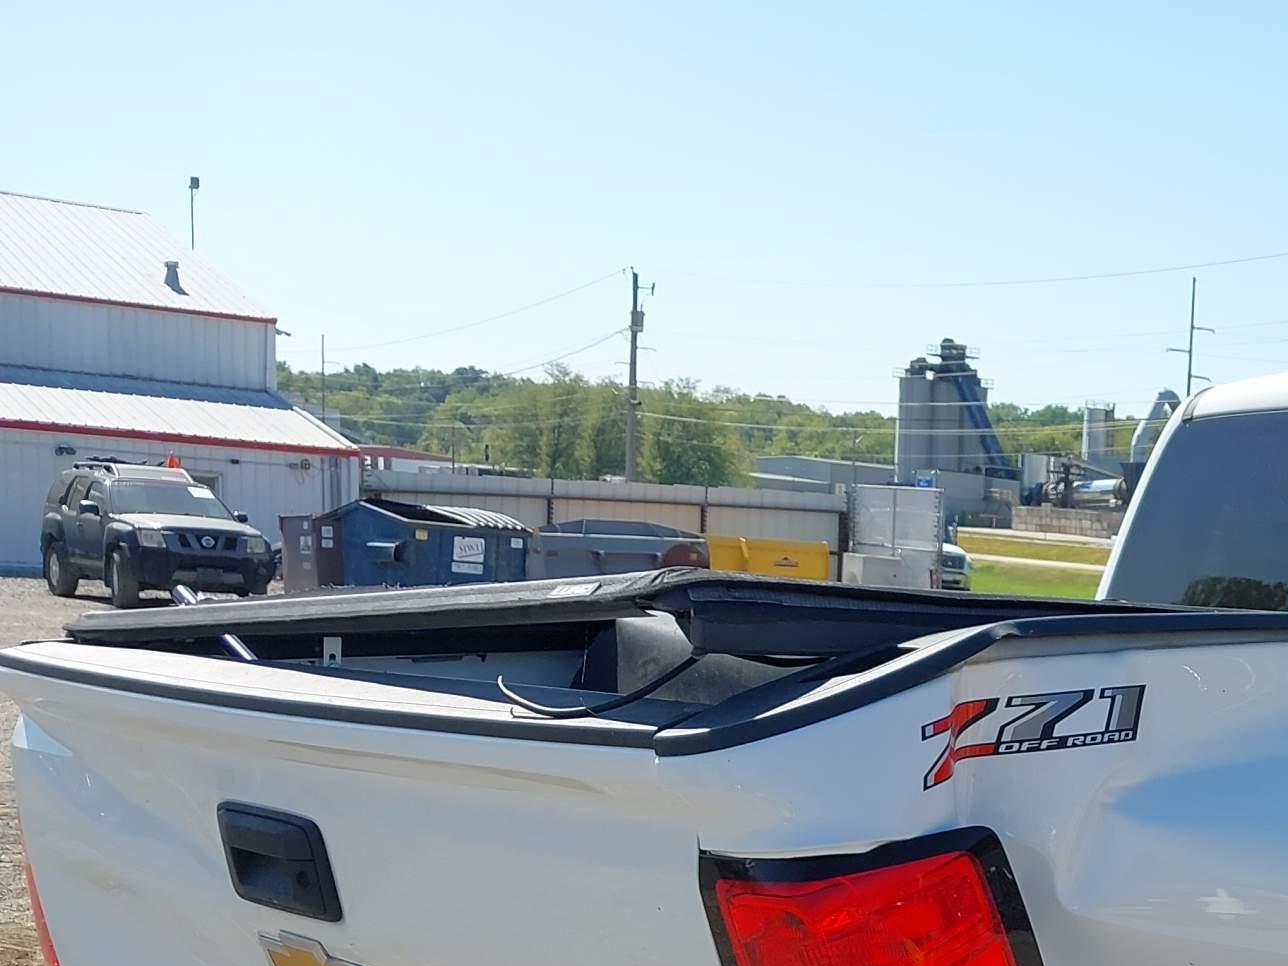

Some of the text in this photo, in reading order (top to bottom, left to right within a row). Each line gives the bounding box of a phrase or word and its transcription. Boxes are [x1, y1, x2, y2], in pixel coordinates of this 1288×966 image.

[921, 684, 1147, 792] Z71
[998, 729, 1134, 754] OFF ROAD
